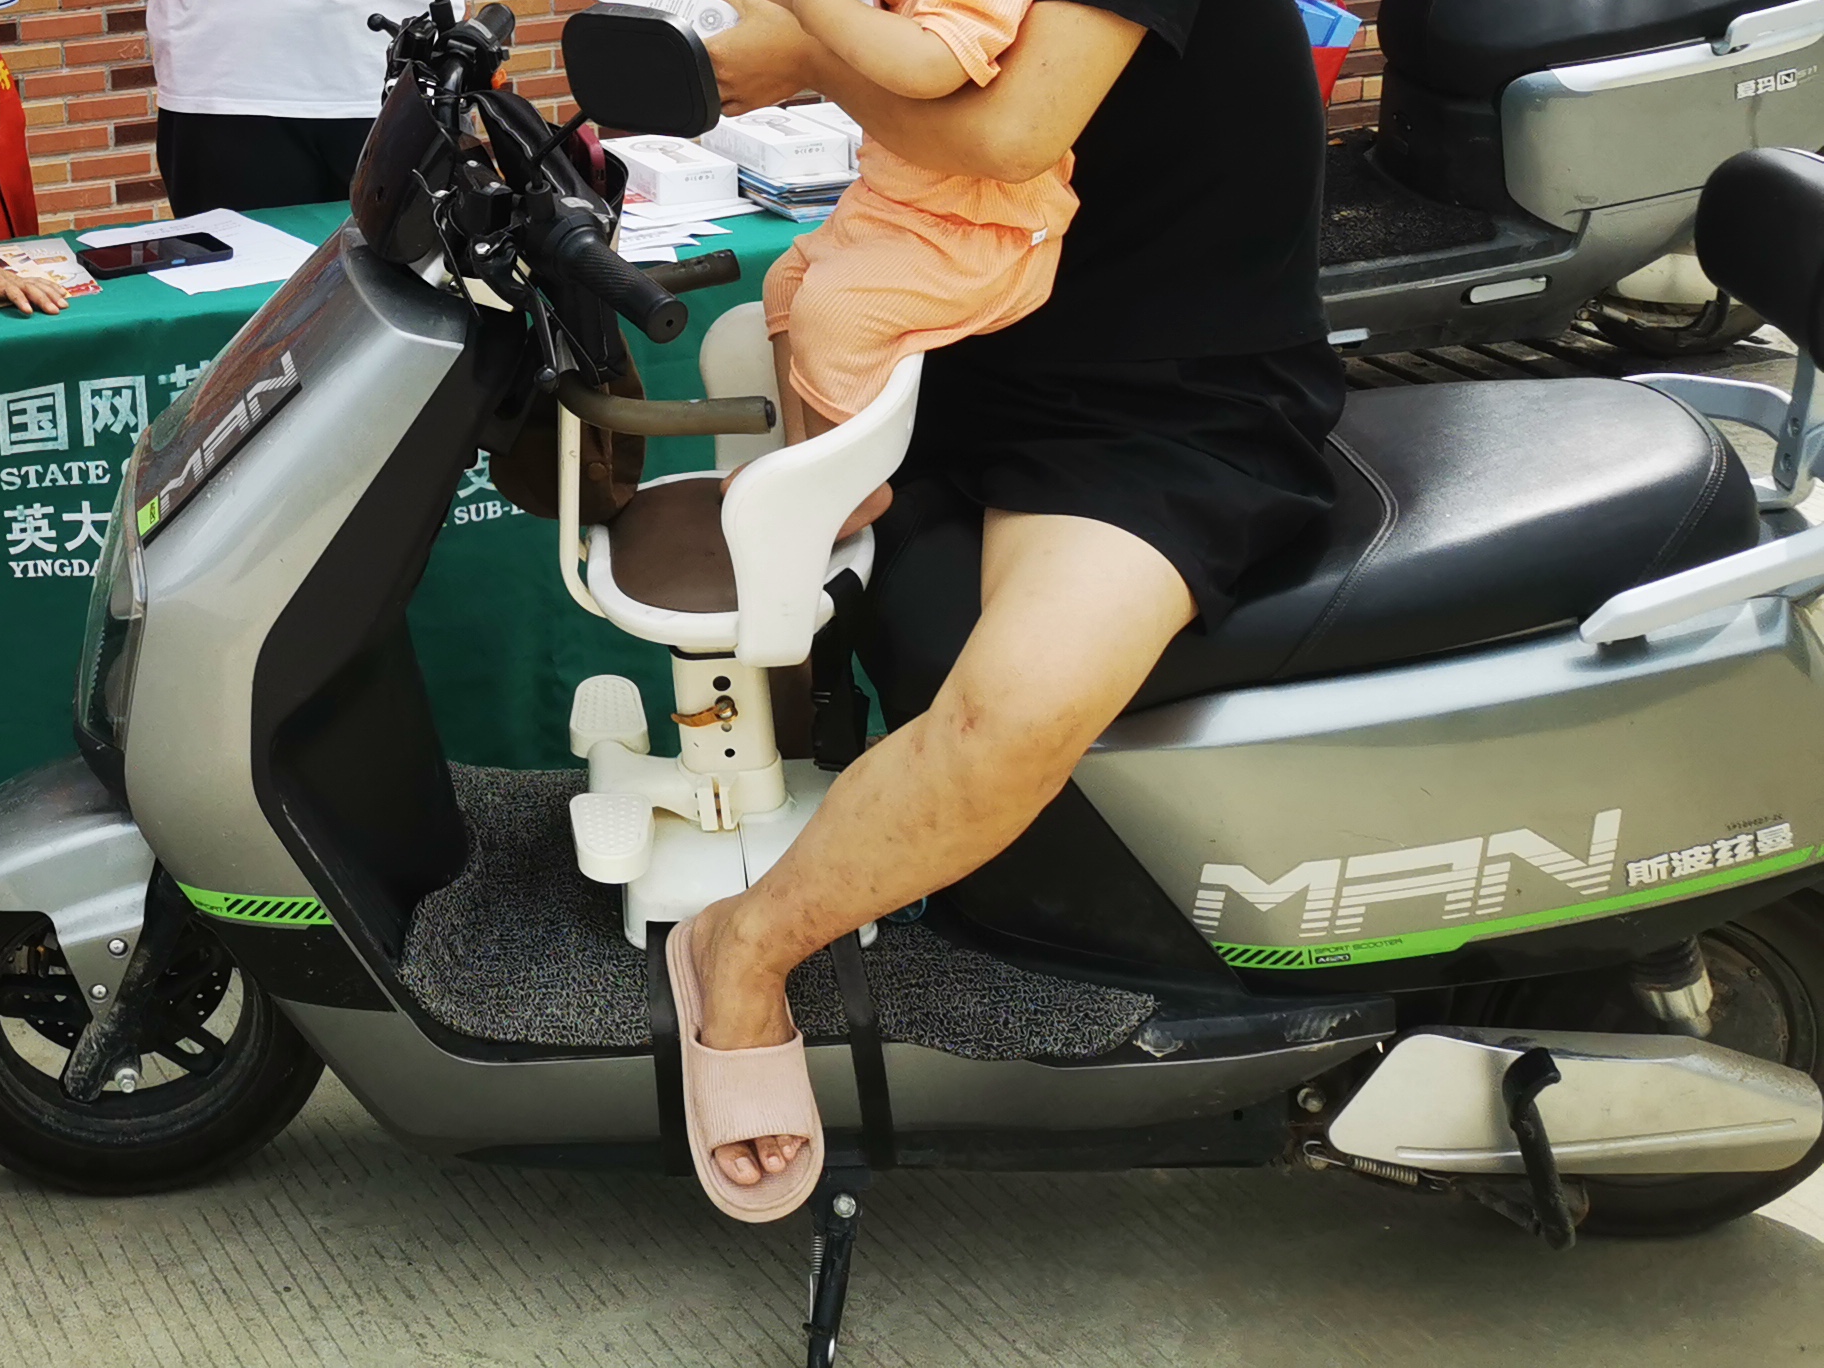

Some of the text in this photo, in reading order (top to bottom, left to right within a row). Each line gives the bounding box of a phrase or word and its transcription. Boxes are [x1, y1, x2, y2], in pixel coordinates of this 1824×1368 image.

[0, 459, 111, 491] STATE
[3, 500, 113, 555] 英大
[1193, 807, 1622, 938] MAN
